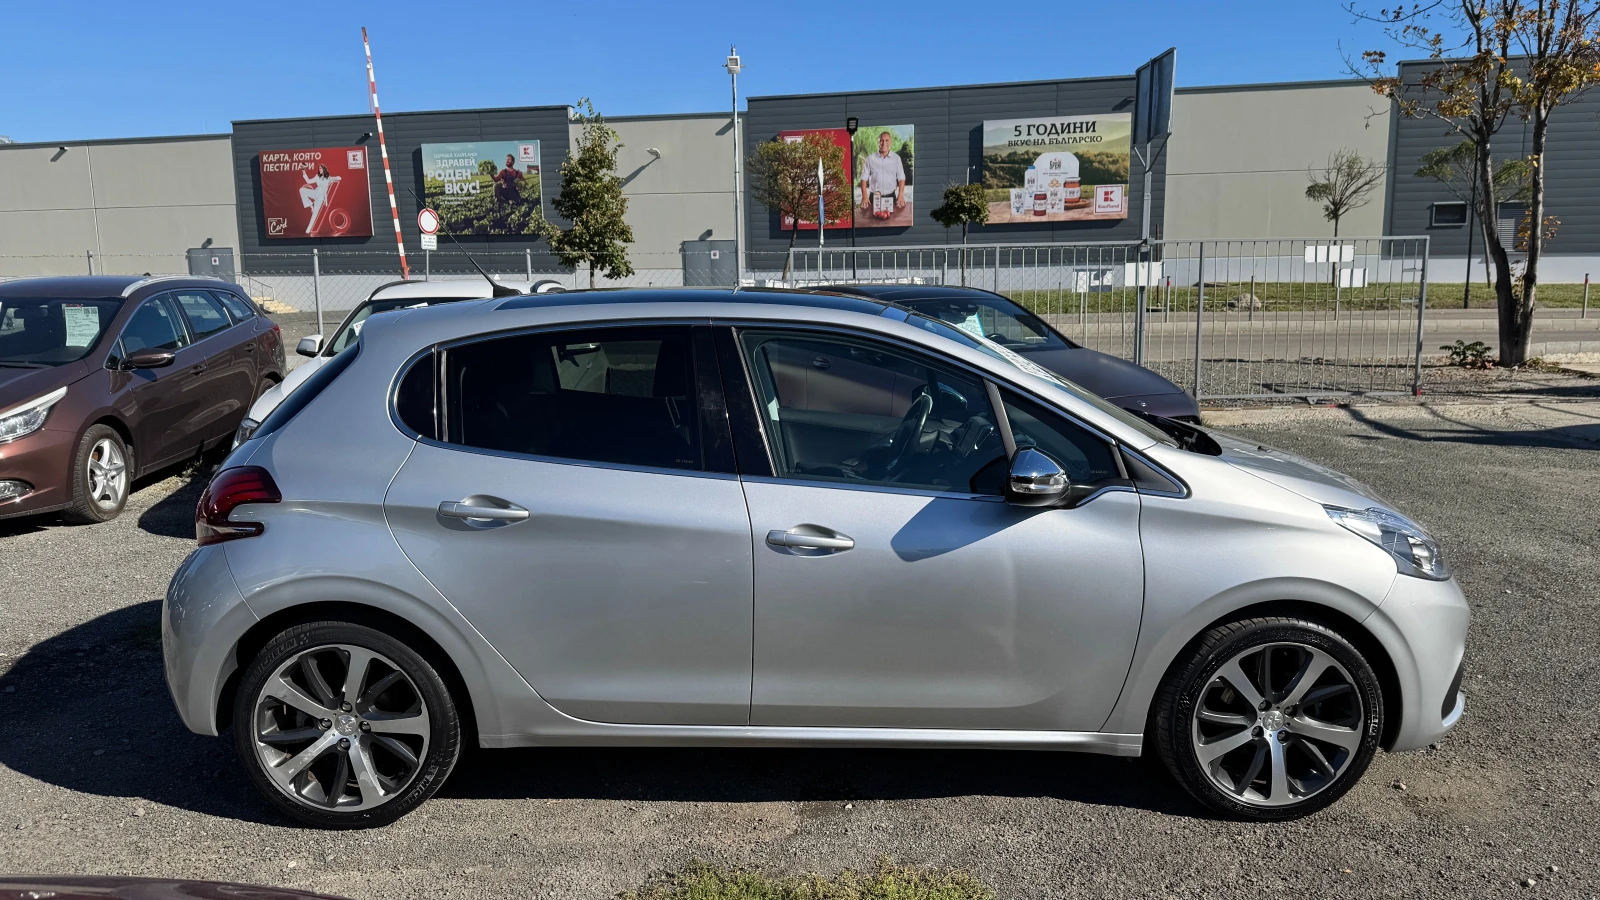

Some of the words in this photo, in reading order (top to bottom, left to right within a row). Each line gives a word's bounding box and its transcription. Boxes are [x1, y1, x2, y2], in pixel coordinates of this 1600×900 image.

[1013, 124, 1022, 137] 5
[1026, 121, 1097, 137] ГОДИНИ
[1007, 139, 1031, 147] ВКУС
[1048, 135, 1103, 145] БЪЛГАРСКО
[262, 153, 291, 162] КАРТА,
[293, 152, 322, 161] КОЯТО
[436, 157, 478, 168] ЗДРАВЕЙ,
[263, 163, 290, 172] ПЕСТИ
[427, 168, 472, 182] РОДЕН
[444, 180, 480, 194] ВКУС!
